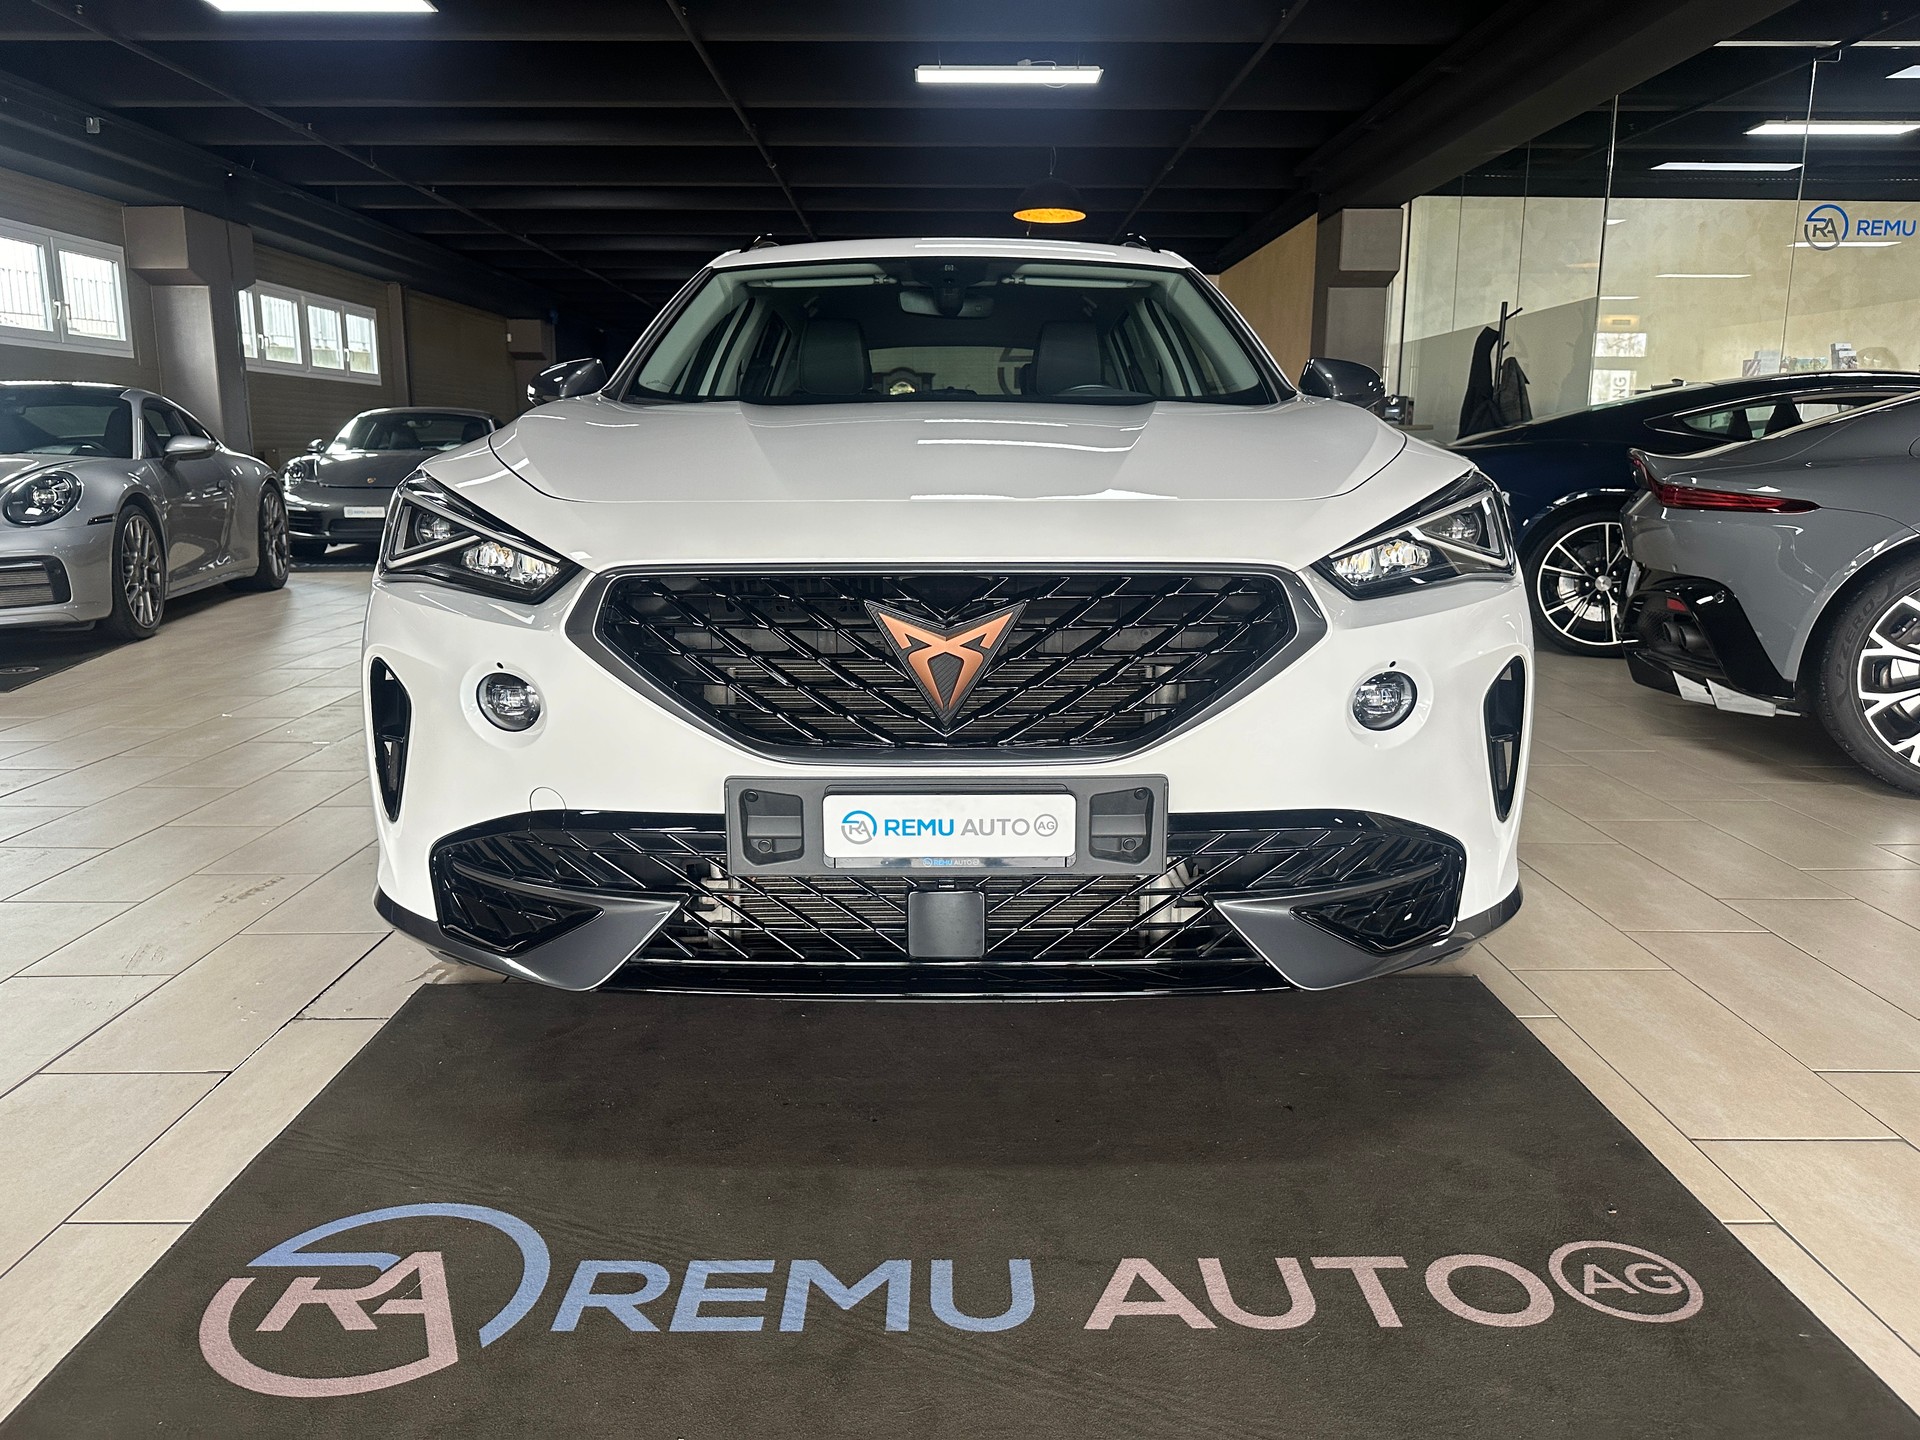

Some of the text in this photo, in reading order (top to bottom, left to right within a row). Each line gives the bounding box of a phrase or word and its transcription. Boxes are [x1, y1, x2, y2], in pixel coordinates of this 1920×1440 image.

[1856, 219, 1917, 237] REMU
[1839, 597, 1875, 660] ZERO
[884, 818, 955, 836] REMU
[960, 818, 1031, 836] AUTO
[1037, 821, 1055, 831] AG
[550, 1258, 1036, 1334] REMU
[1083, 1253, 1555, 1330] AUTO
[1582, 1261, 1684, 1296] AG
